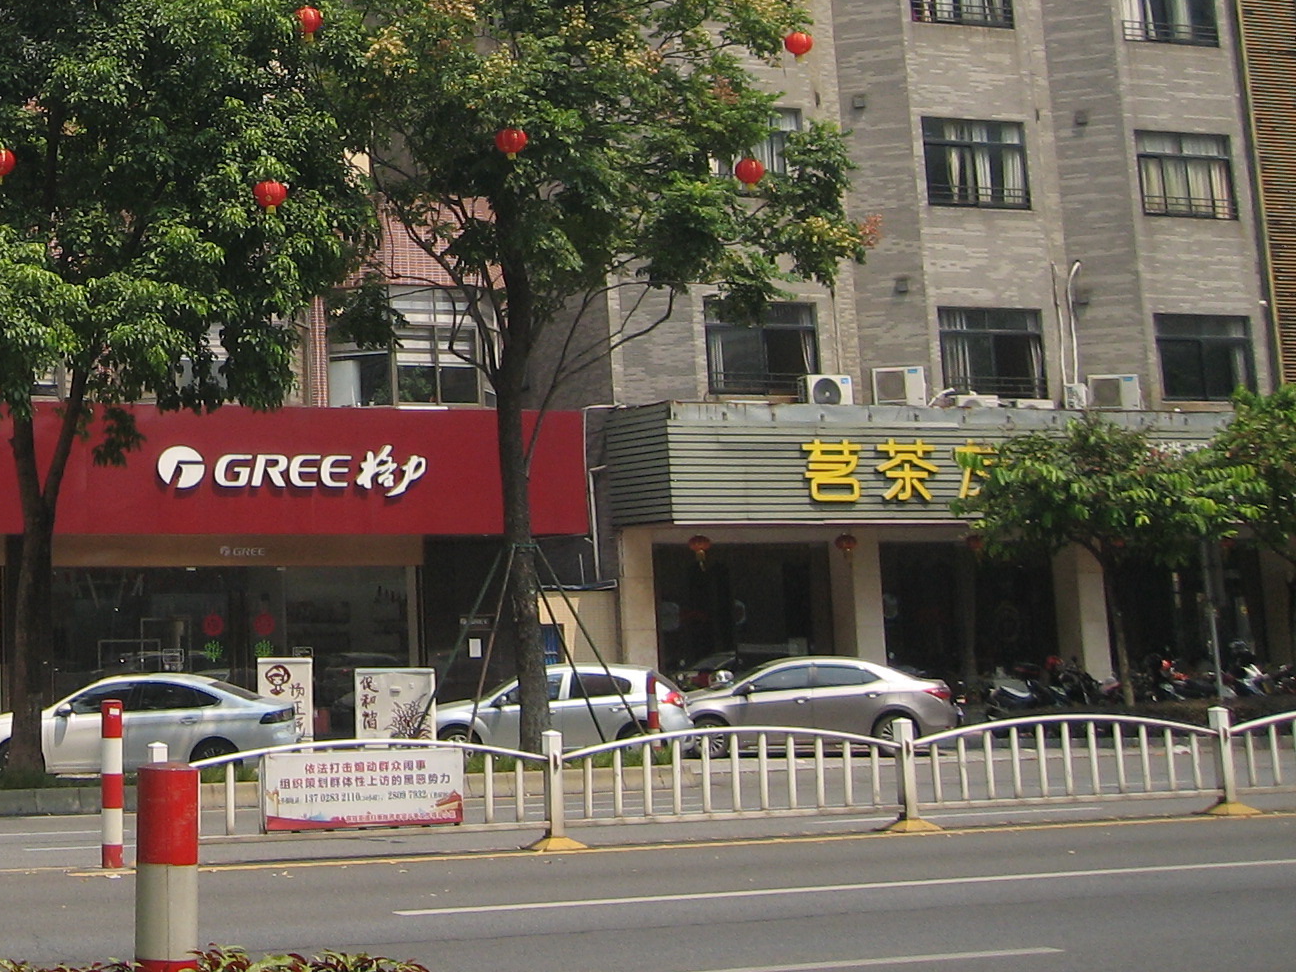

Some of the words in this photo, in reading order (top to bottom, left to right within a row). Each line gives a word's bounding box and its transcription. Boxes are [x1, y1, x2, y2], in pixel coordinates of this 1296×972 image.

[214, 454, 352, 488] GREE
[356, 444, 427, 497] 格力
[233, 547, 265, 556] GREE
[279, 773, 452, 790] 组织策划群体性上访的黑恶势力
